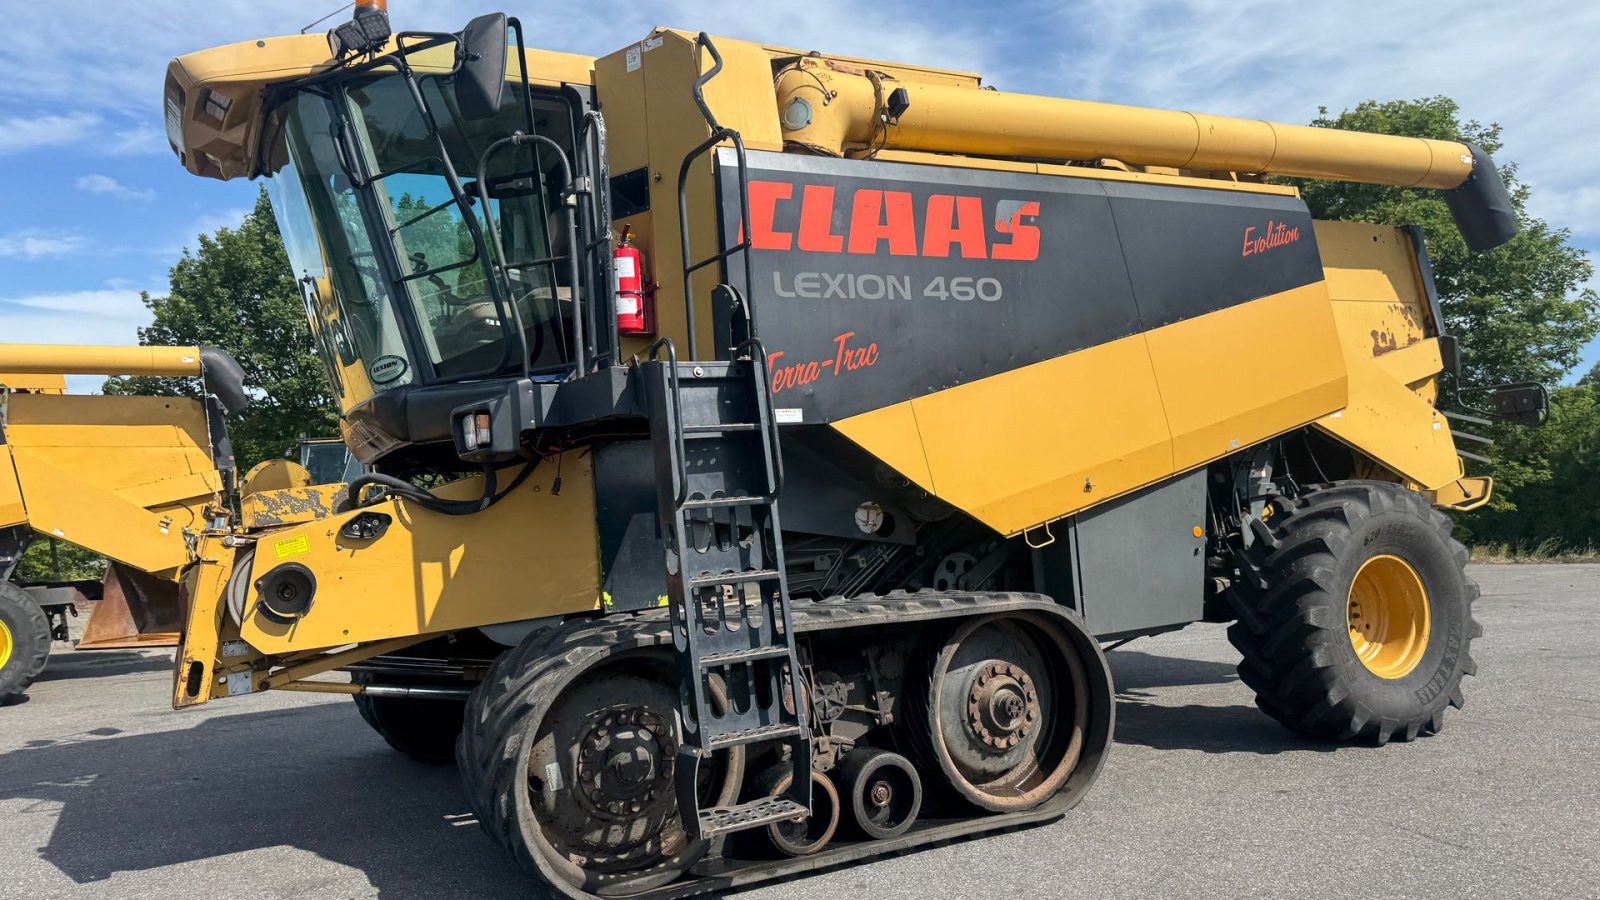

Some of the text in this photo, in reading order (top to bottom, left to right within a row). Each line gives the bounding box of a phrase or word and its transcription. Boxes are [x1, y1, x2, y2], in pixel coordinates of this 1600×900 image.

[738, 180, 1041, 261] CLAAS
[1243, 220, 1300, 257] Evolution
[773, 271, 1003, 302] LEXION 460
[373, 361, 398, 373] LEXION
